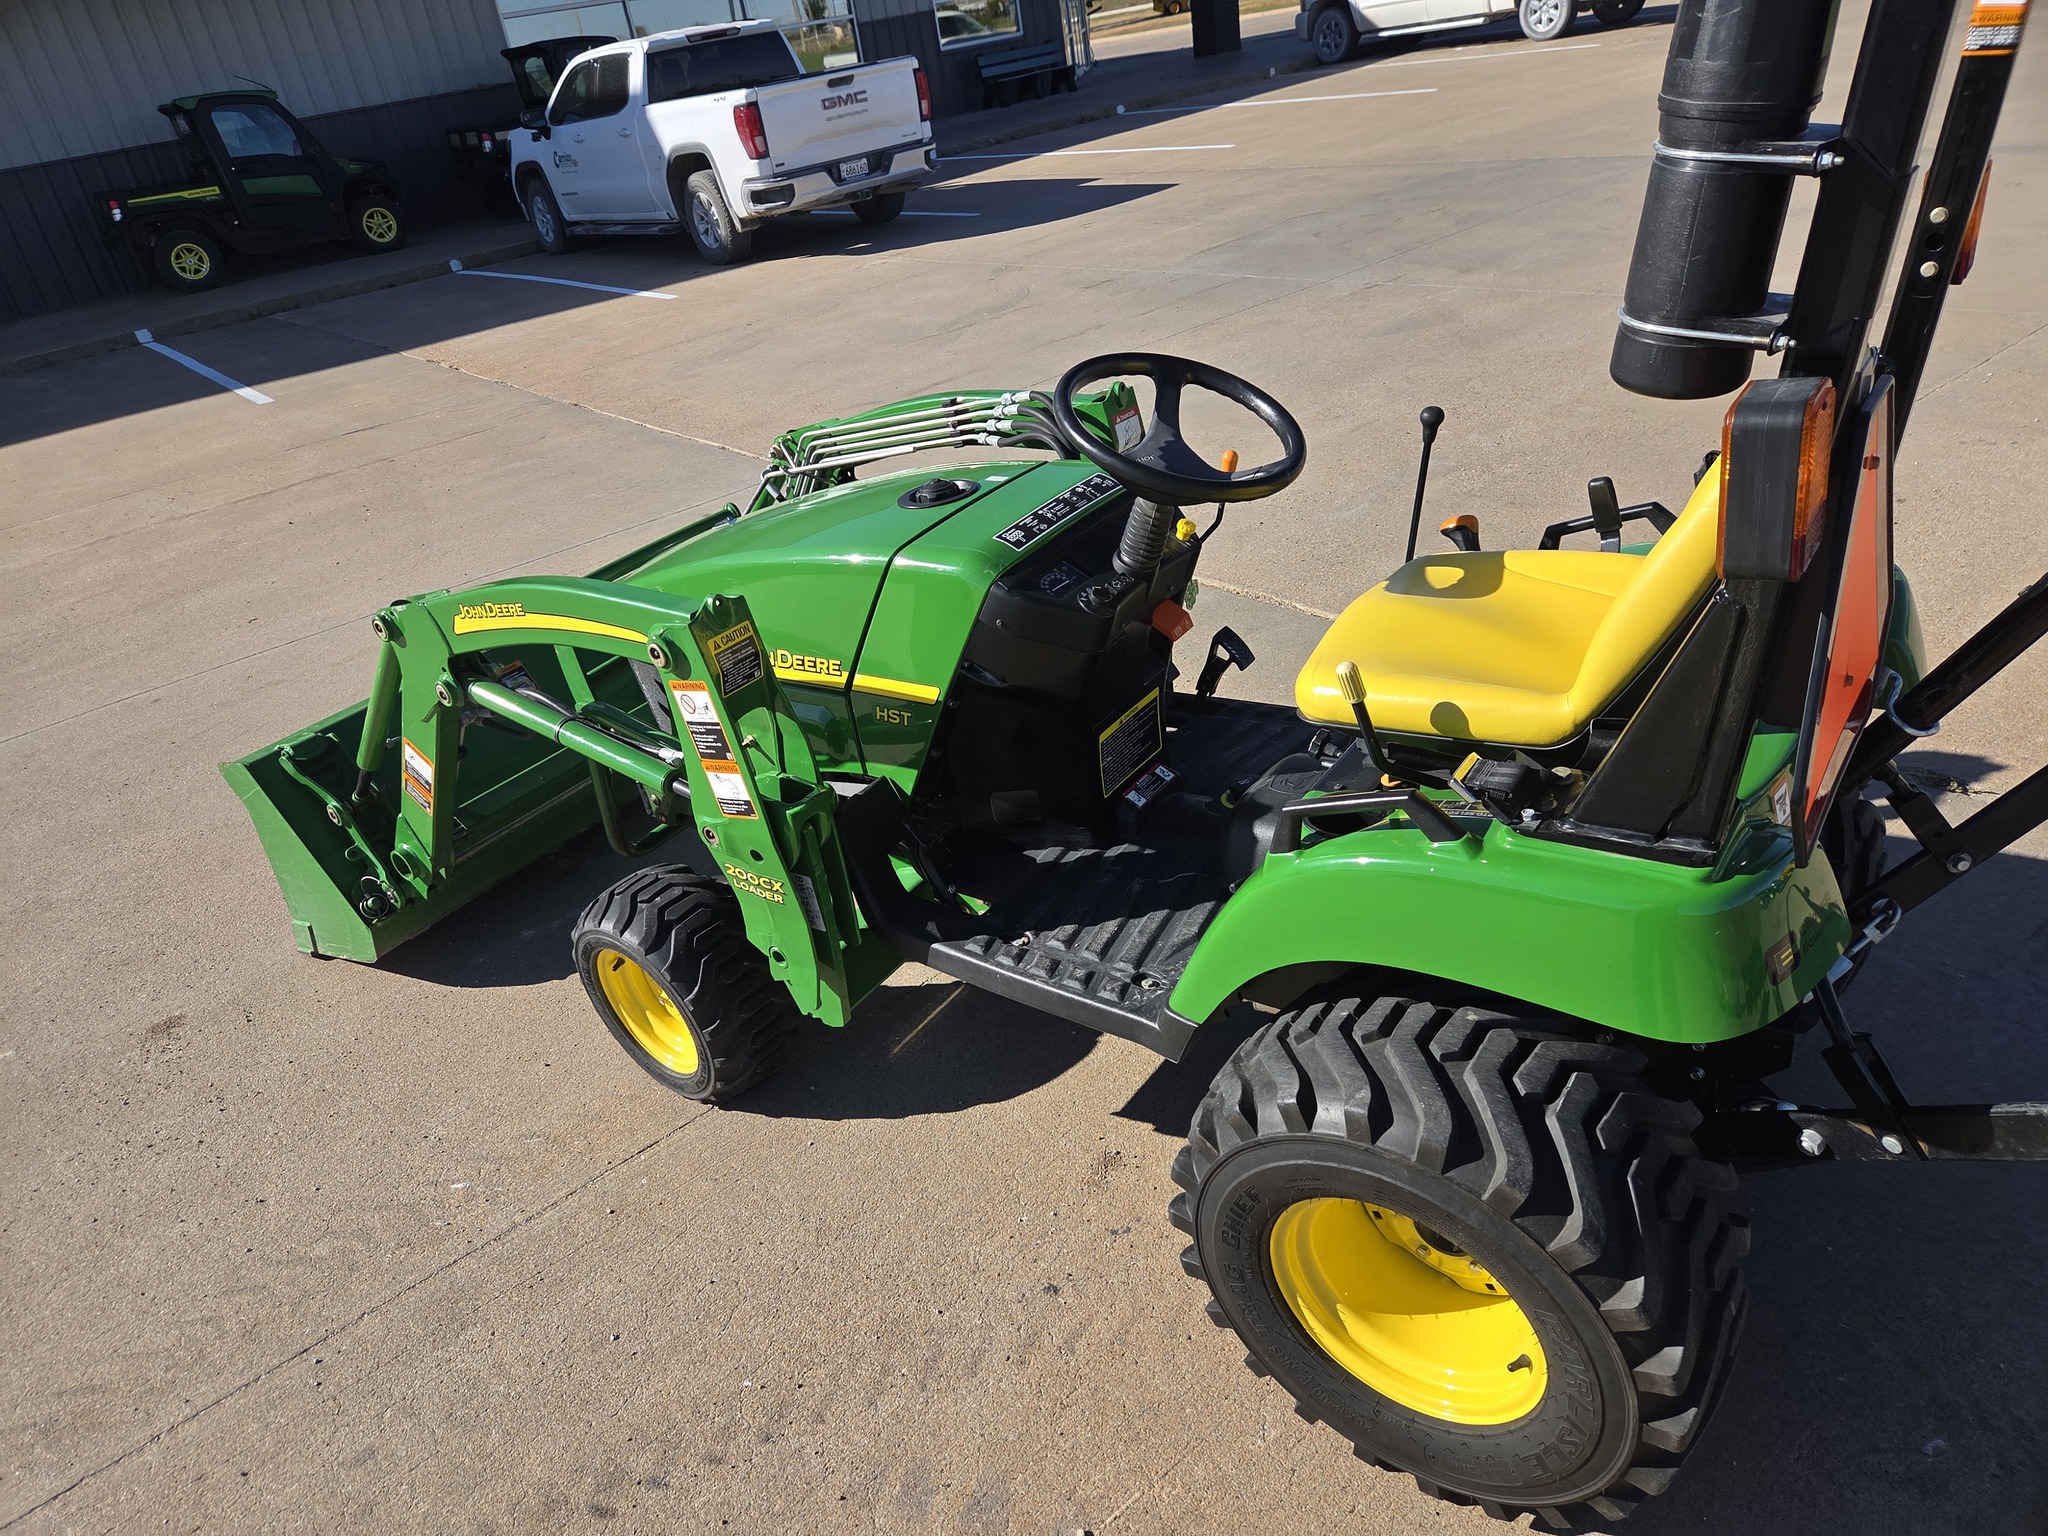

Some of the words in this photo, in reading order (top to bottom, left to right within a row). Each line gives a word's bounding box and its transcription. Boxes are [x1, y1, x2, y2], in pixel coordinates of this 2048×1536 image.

[1979, 12, 2022, 22] WARNIN
[821, 90, 869, 111] GMC
[720, 623, 751, 647] CAUTION
[678, 682, 706, 690] WARNING
[875, 705, 912, 726] HST
[710, 764, 738, 773] WARNING
[724, 862, 787, 895] 200CX
[733, 878, 785, 905] LOADER
[1222, 1185, 1261, 1250] CHIEF
[1522, 1308, 1596, 1481] CARLISLE
